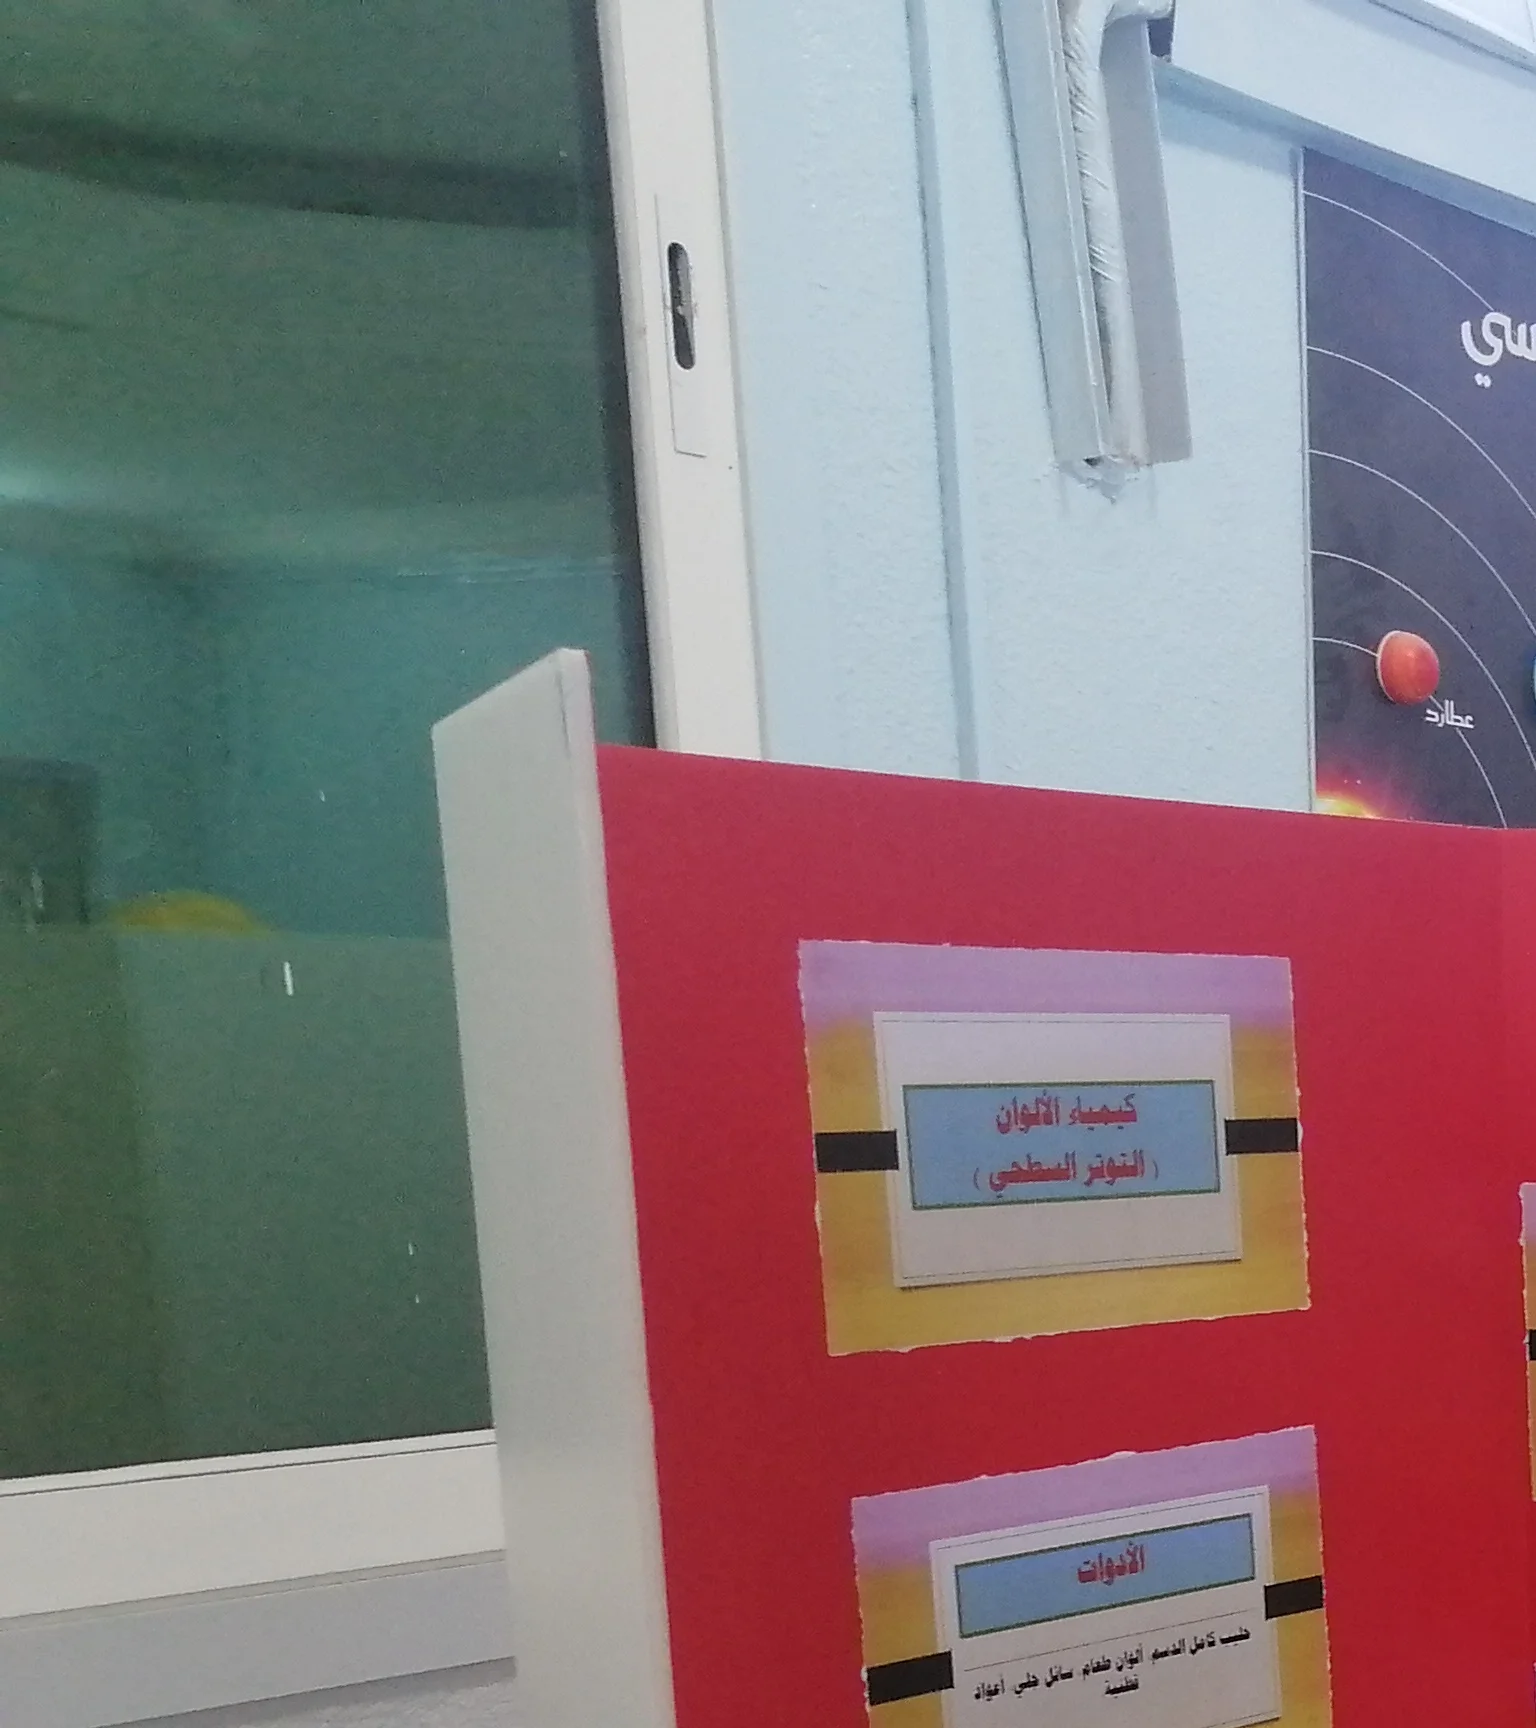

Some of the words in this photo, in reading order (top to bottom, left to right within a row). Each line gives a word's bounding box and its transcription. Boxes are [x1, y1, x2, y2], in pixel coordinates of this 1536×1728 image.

[1425, 700, 1475, 730] عطارد
[995, 1088, 1061, 1134] الألوان
[1067, 1092, 1138, 1132] كيمياء
[1077, 1541, 1146, 1586] الأدوات
[1219, 1627, 1251, 1648] حليب
